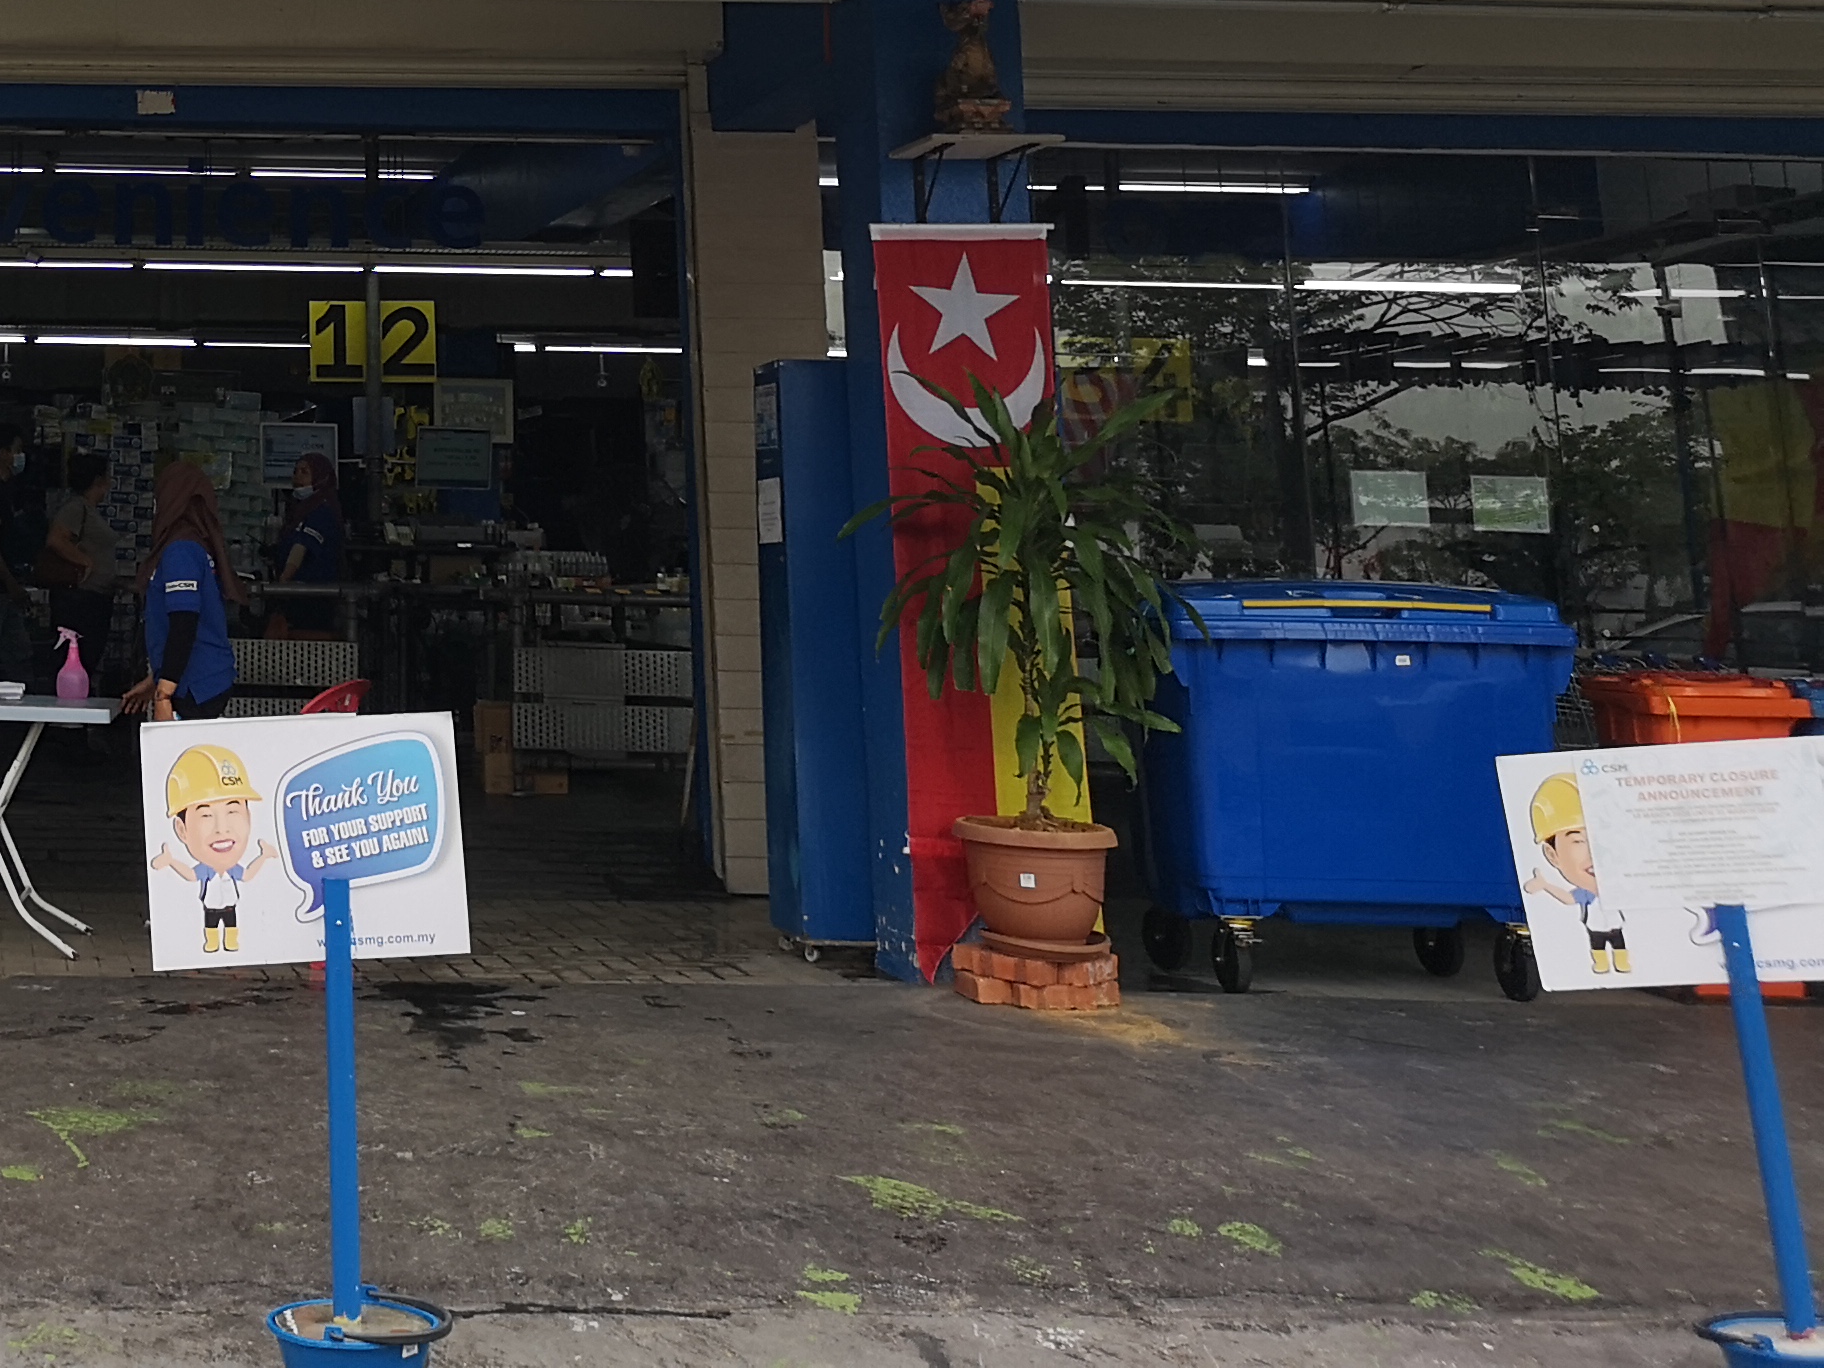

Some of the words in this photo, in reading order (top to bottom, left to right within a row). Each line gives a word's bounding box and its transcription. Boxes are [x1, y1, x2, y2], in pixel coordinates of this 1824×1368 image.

[313, 303, 436, 378] 12
[221, 775, 244, 787] CSM
[1601, 763, 1629, 773] CSM
[1615, 772, 1707, 788] TEMPORARY
[1710, 769, 1780, 781] CLOSURE
[285, 778, 368, 822] Thank
[368, 769, 420, 805] You
[1636, 785, 1764, 803] ANNOUNCEMENT
[301, 826, 330, 849] FOR
[330, 818, 368, 843] YOUR
[368, 803, 429, 832] SUPPORT
[311, 850, 325, 869] &
[325, 844, 351, 865] SEE
[352, 836, 381, 862] YOU
[382, 826, 430, 854] AGAIN!
